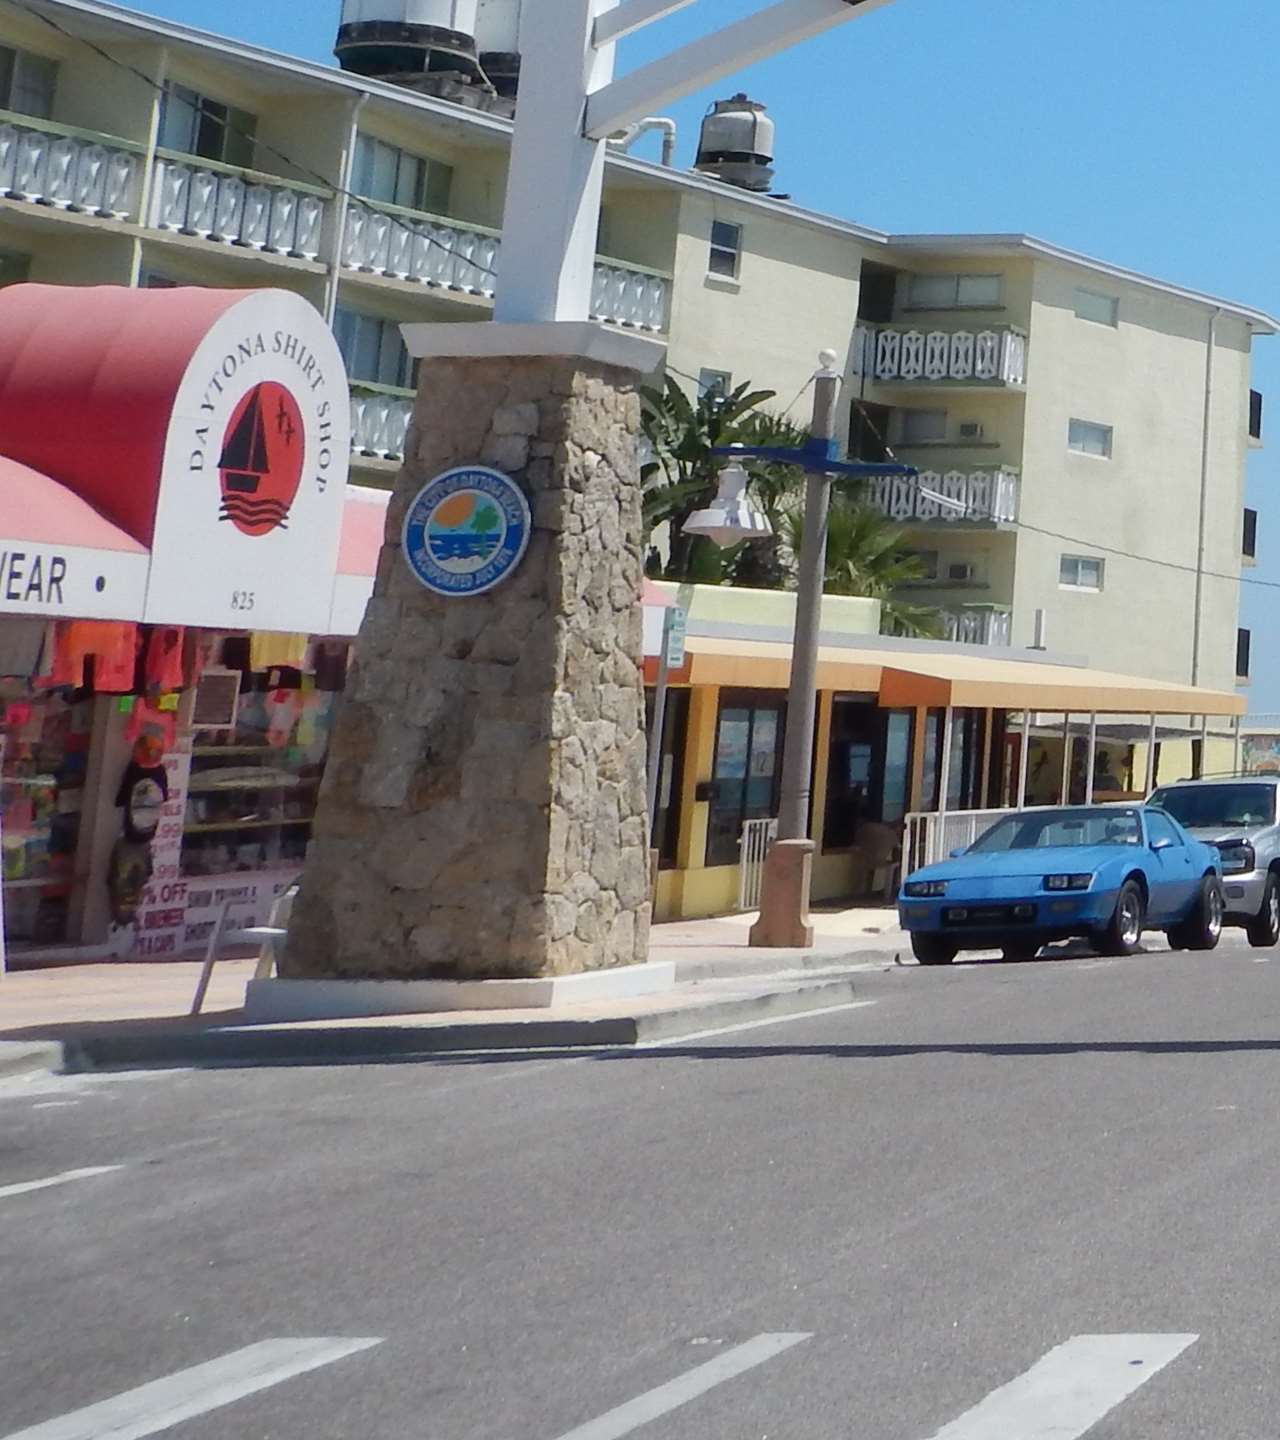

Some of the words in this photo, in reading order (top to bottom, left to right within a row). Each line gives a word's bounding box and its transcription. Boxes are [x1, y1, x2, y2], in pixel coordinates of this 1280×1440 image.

[190, 333, 266, 471] DAYTONA
[272, 331, 325, 392] SHIRT
[316, 401, 331, 493] SHOP
[231, 591, 255, 610] 825
[161, 881, 188, 903] OFF
